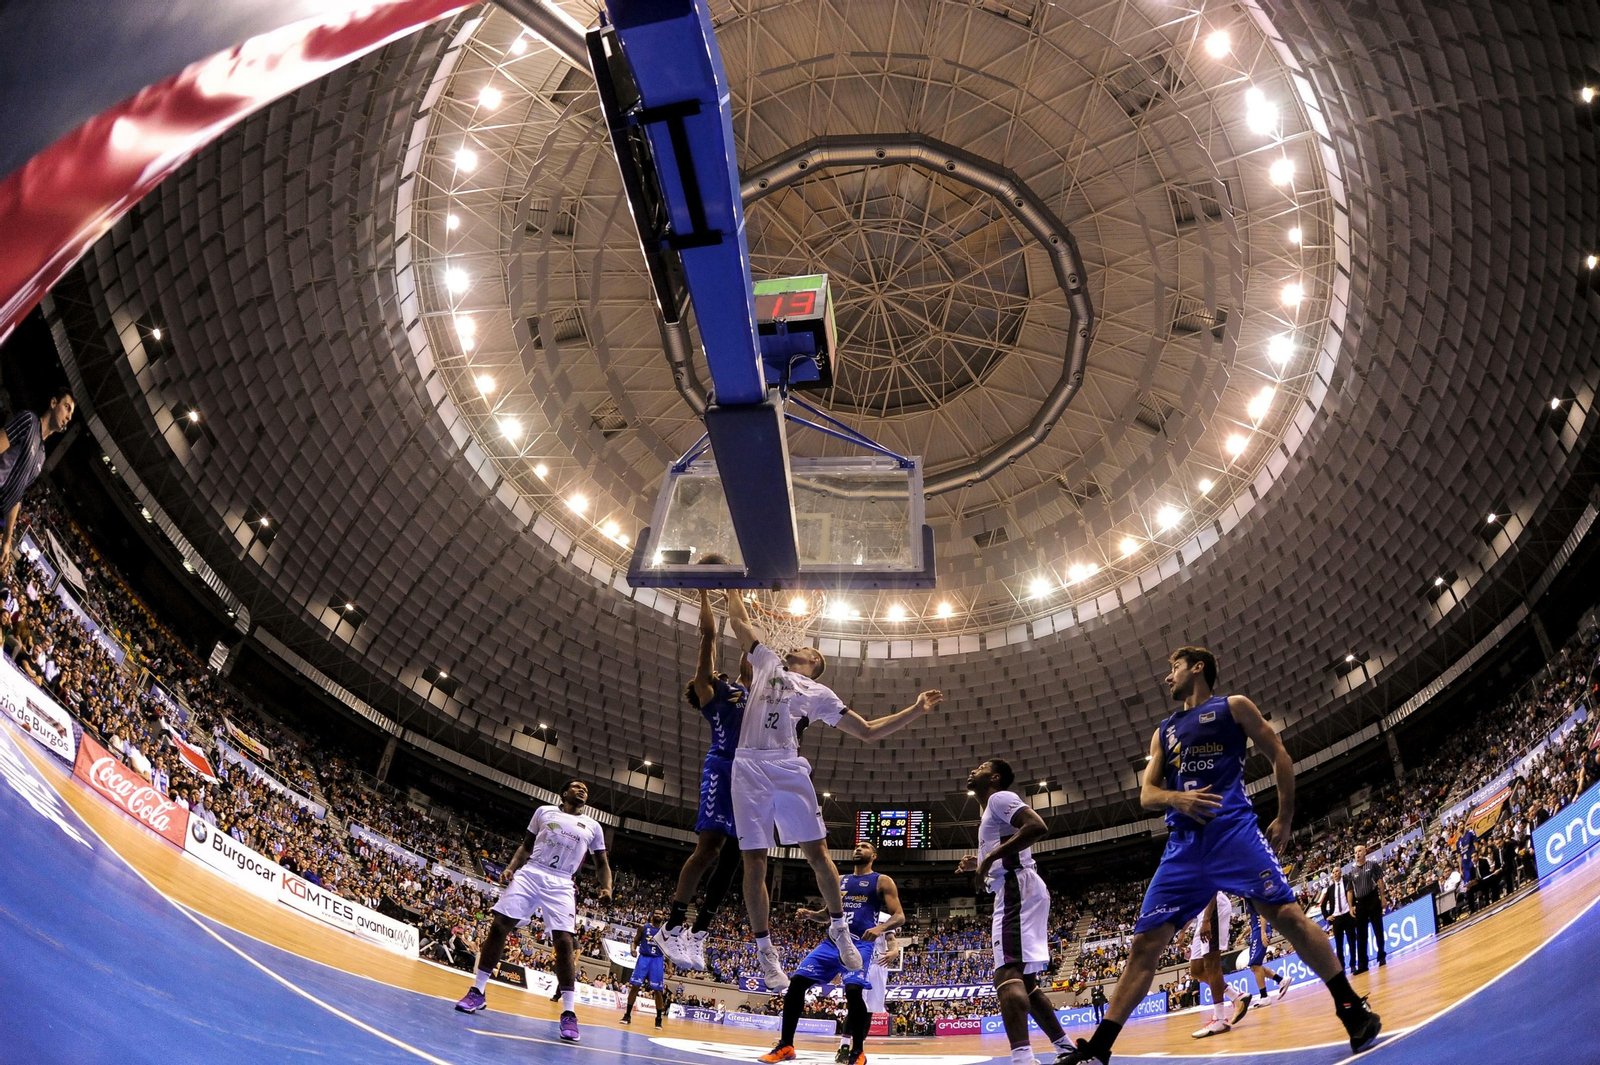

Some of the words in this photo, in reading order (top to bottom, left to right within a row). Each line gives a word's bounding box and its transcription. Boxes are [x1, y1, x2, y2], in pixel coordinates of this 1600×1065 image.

[765, 712, 780, 729] 32
[17, 706, 31, 725] de
[32, 716, 70, 752] Burgos
[1178, 759, 1214, 776] RGOS
[89, 757, 177, 832] Coca-Cola
[896, 819, 906, 827] 50
[212, 832, 277, 883] Burgocar
[549, 855, 560, 869] 2
[916, 985, 997, 999] MONTES
[693, 1010, 711, 1020] atu
[938, 1019, 981, 1030] endesa
